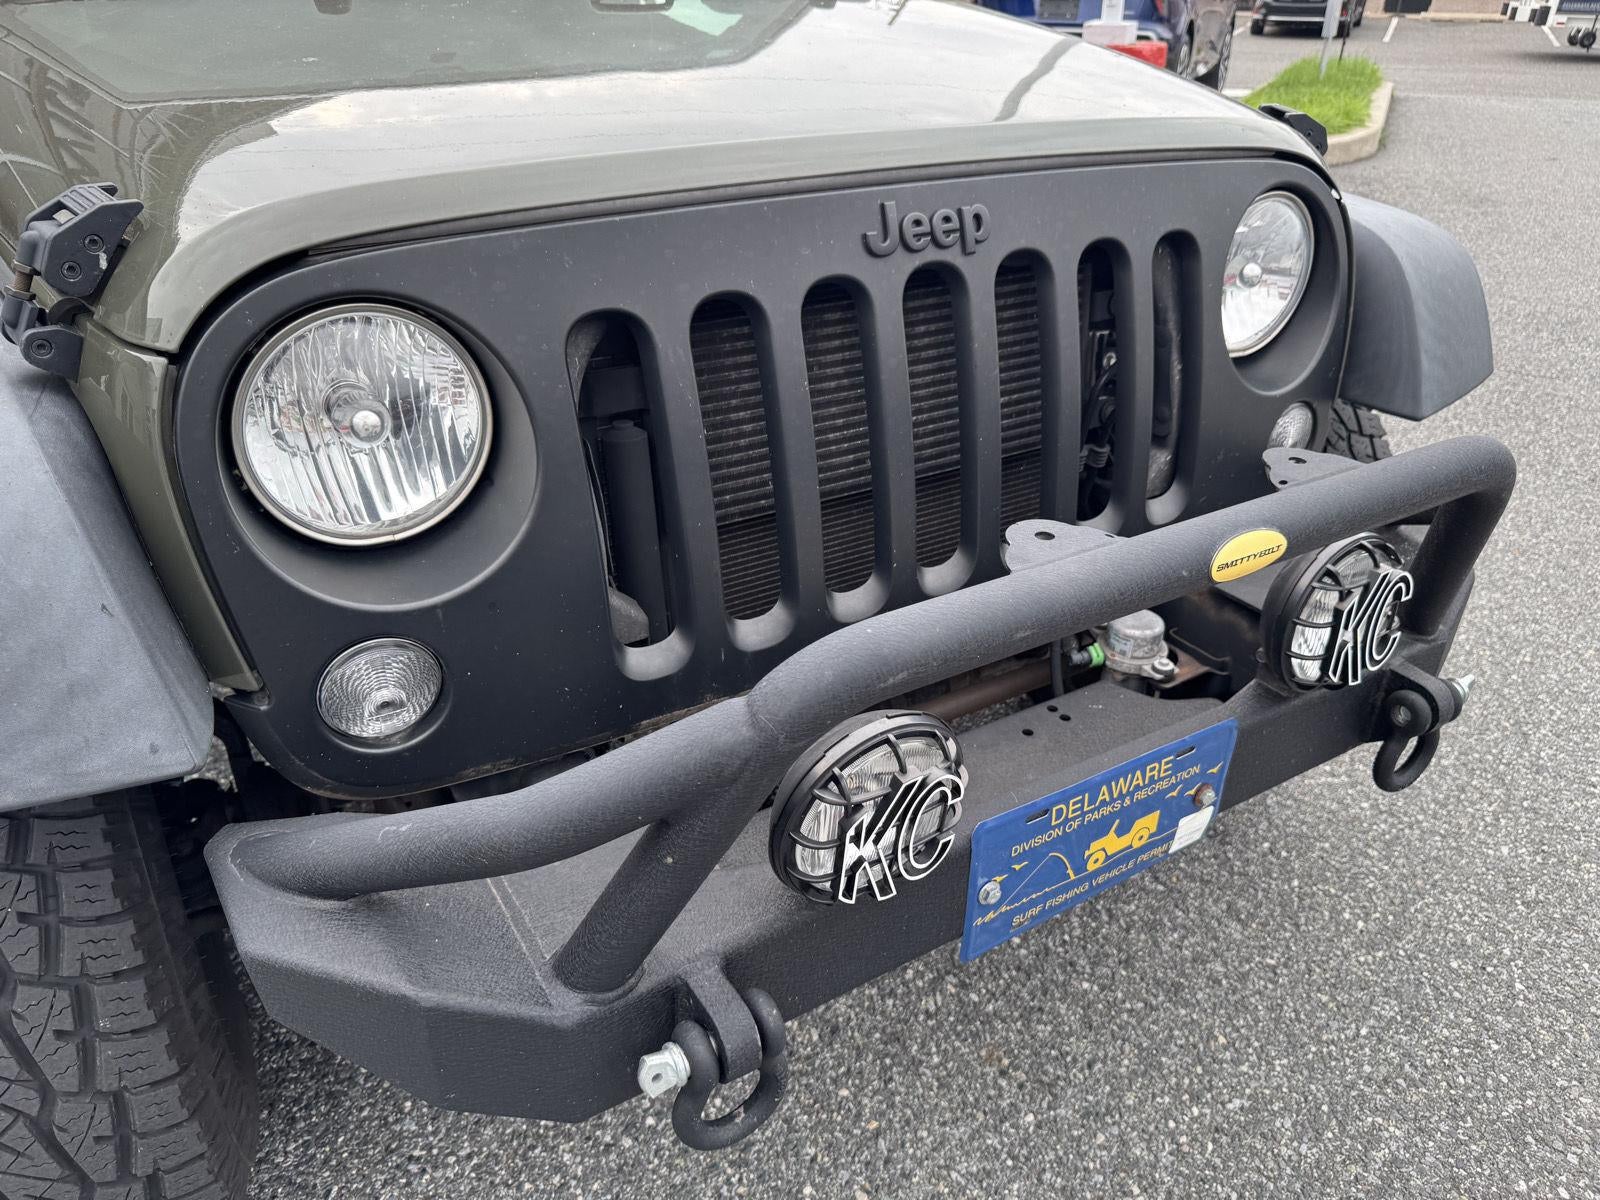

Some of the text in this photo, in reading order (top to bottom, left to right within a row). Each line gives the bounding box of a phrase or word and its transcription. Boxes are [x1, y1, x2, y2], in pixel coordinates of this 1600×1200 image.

[862, 200, 991, 256] Jeep
[1216, 544, 1282, 572] SMITTYBILT
[1329, 569, 1414, 686] KC
[1011, 764, 1200, 857] DIVISION OF PARKS & RECREATION
[1051, 756, 1174, 826] DELAWARE
[838, 774, 964, 904] KC
[1012, 904, 1044, 926] SURF
[1045, 882, 1089, 910] FISHING
[1092, 858, 1136, 887] VEHICLE
